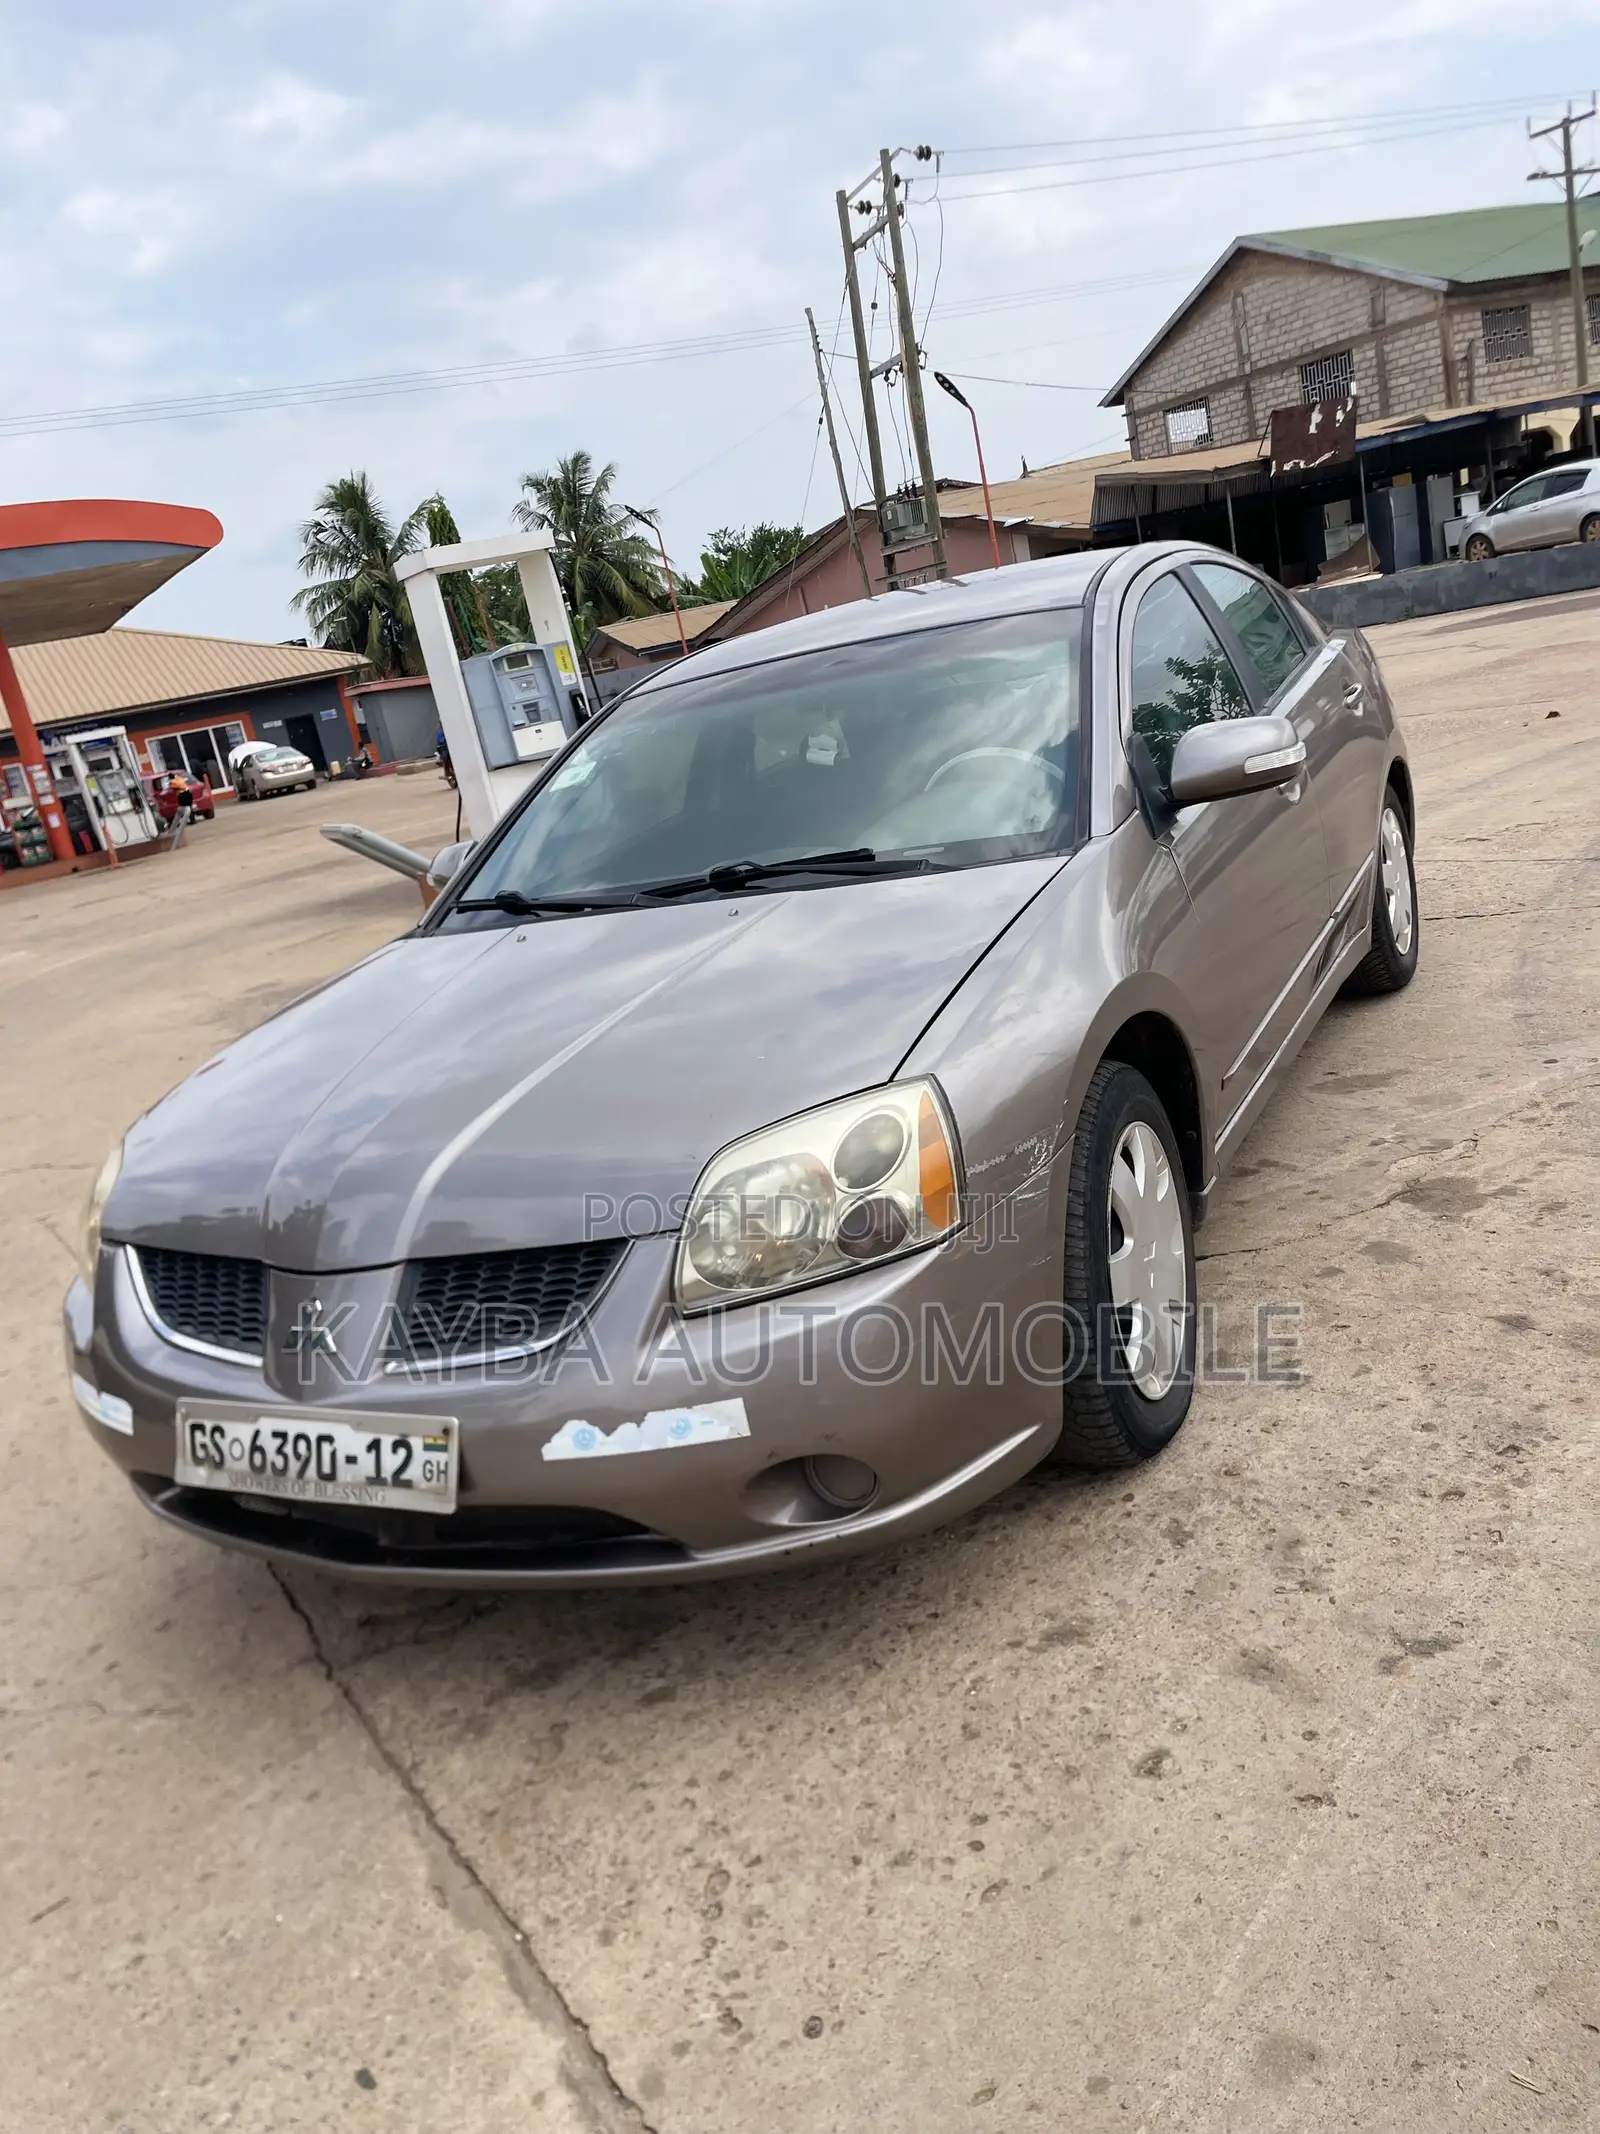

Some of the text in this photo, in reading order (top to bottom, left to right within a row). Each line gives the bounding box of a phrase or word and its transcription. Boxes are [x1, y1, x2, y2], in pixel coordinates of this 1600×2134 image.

[189, 1423, 225, 1469] GS
[422, 1459, 449, 1484] GH
[291, 1481, 310, 1497] OF
[314, 1482, 387, 1504] BLESSING
